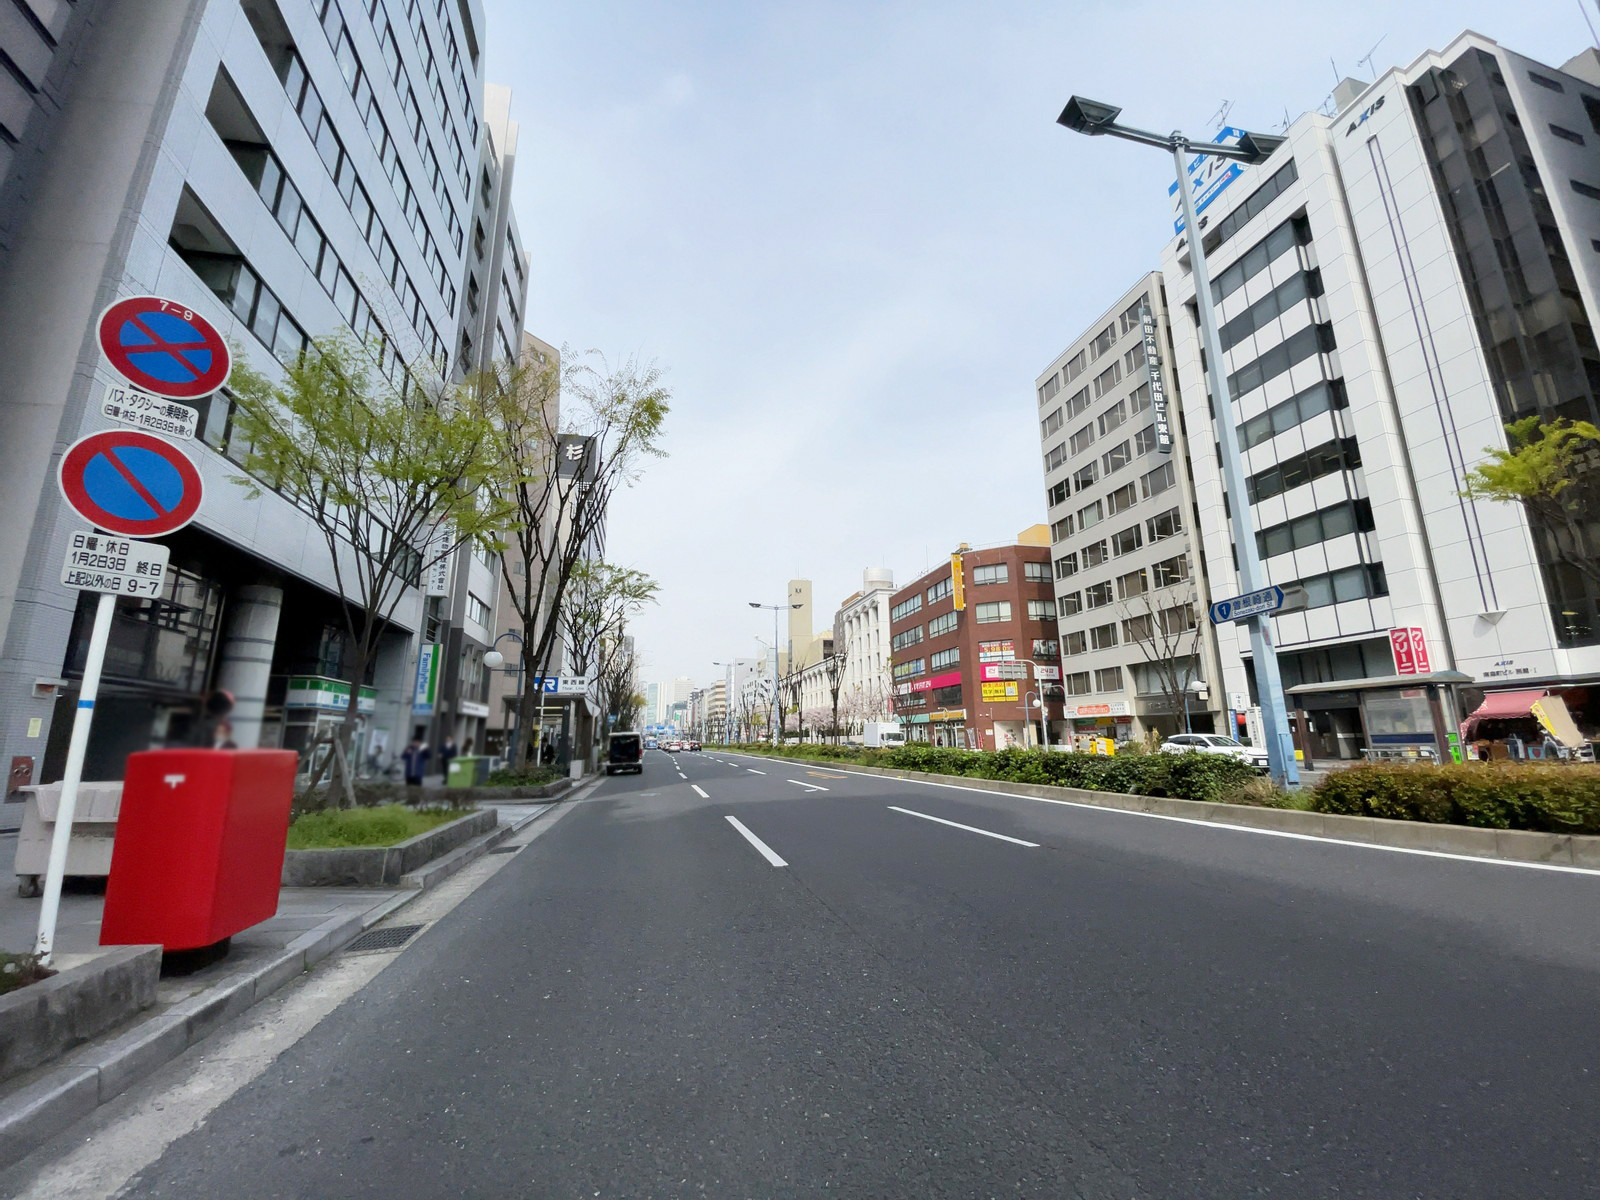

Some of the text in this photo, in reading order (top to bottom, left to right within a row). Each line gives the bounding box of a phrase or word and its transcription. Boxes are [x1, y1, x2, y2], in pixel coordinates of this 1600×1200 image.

[1345, 95, 1385, 138] AXIS
[565, 443, 584, 461] 杉
[71, 550, 162, 577] 1月2日3日 終日
[64, 570, 122, 591] 上記以外の日
[1221, 604, 1227, 616] 1
